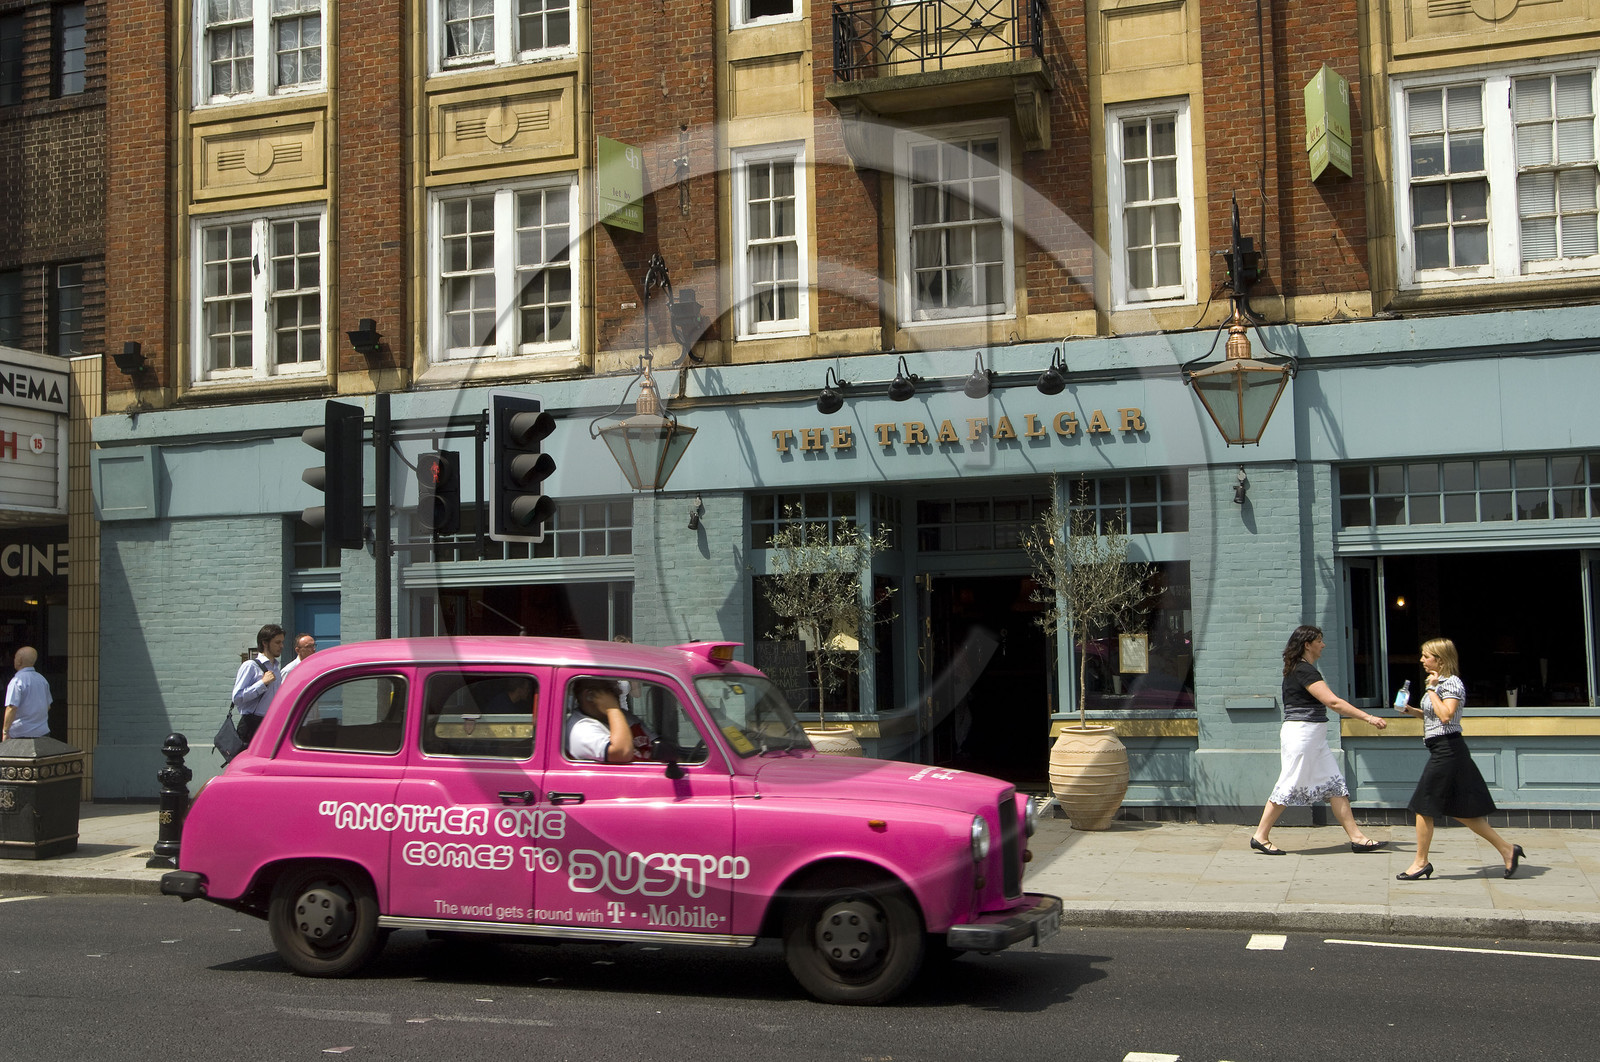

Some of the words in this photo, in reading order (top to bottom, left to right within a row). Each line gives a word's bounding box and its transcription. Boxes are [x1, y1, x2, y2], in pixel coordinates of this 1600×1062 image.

[0, 371, 63, 404] NEMA
[33, 438, 43, 450] 15
[771, 425, 853, 452] THE
[874, 407, 1146, 446] TRAFALGAR
[1, 543, 69, 577] CINE
[494, 808, 567, 840] ONE
[402, 841, 514, 870] COMES
[519, 846, 563, 873] TO
[434, 900, 459, 915] The
[461, 903, 493, 917] word
[496, 905, 524, 920] gets
[526, 908, 573, 922] around
[576, 909, 604, 923] with
